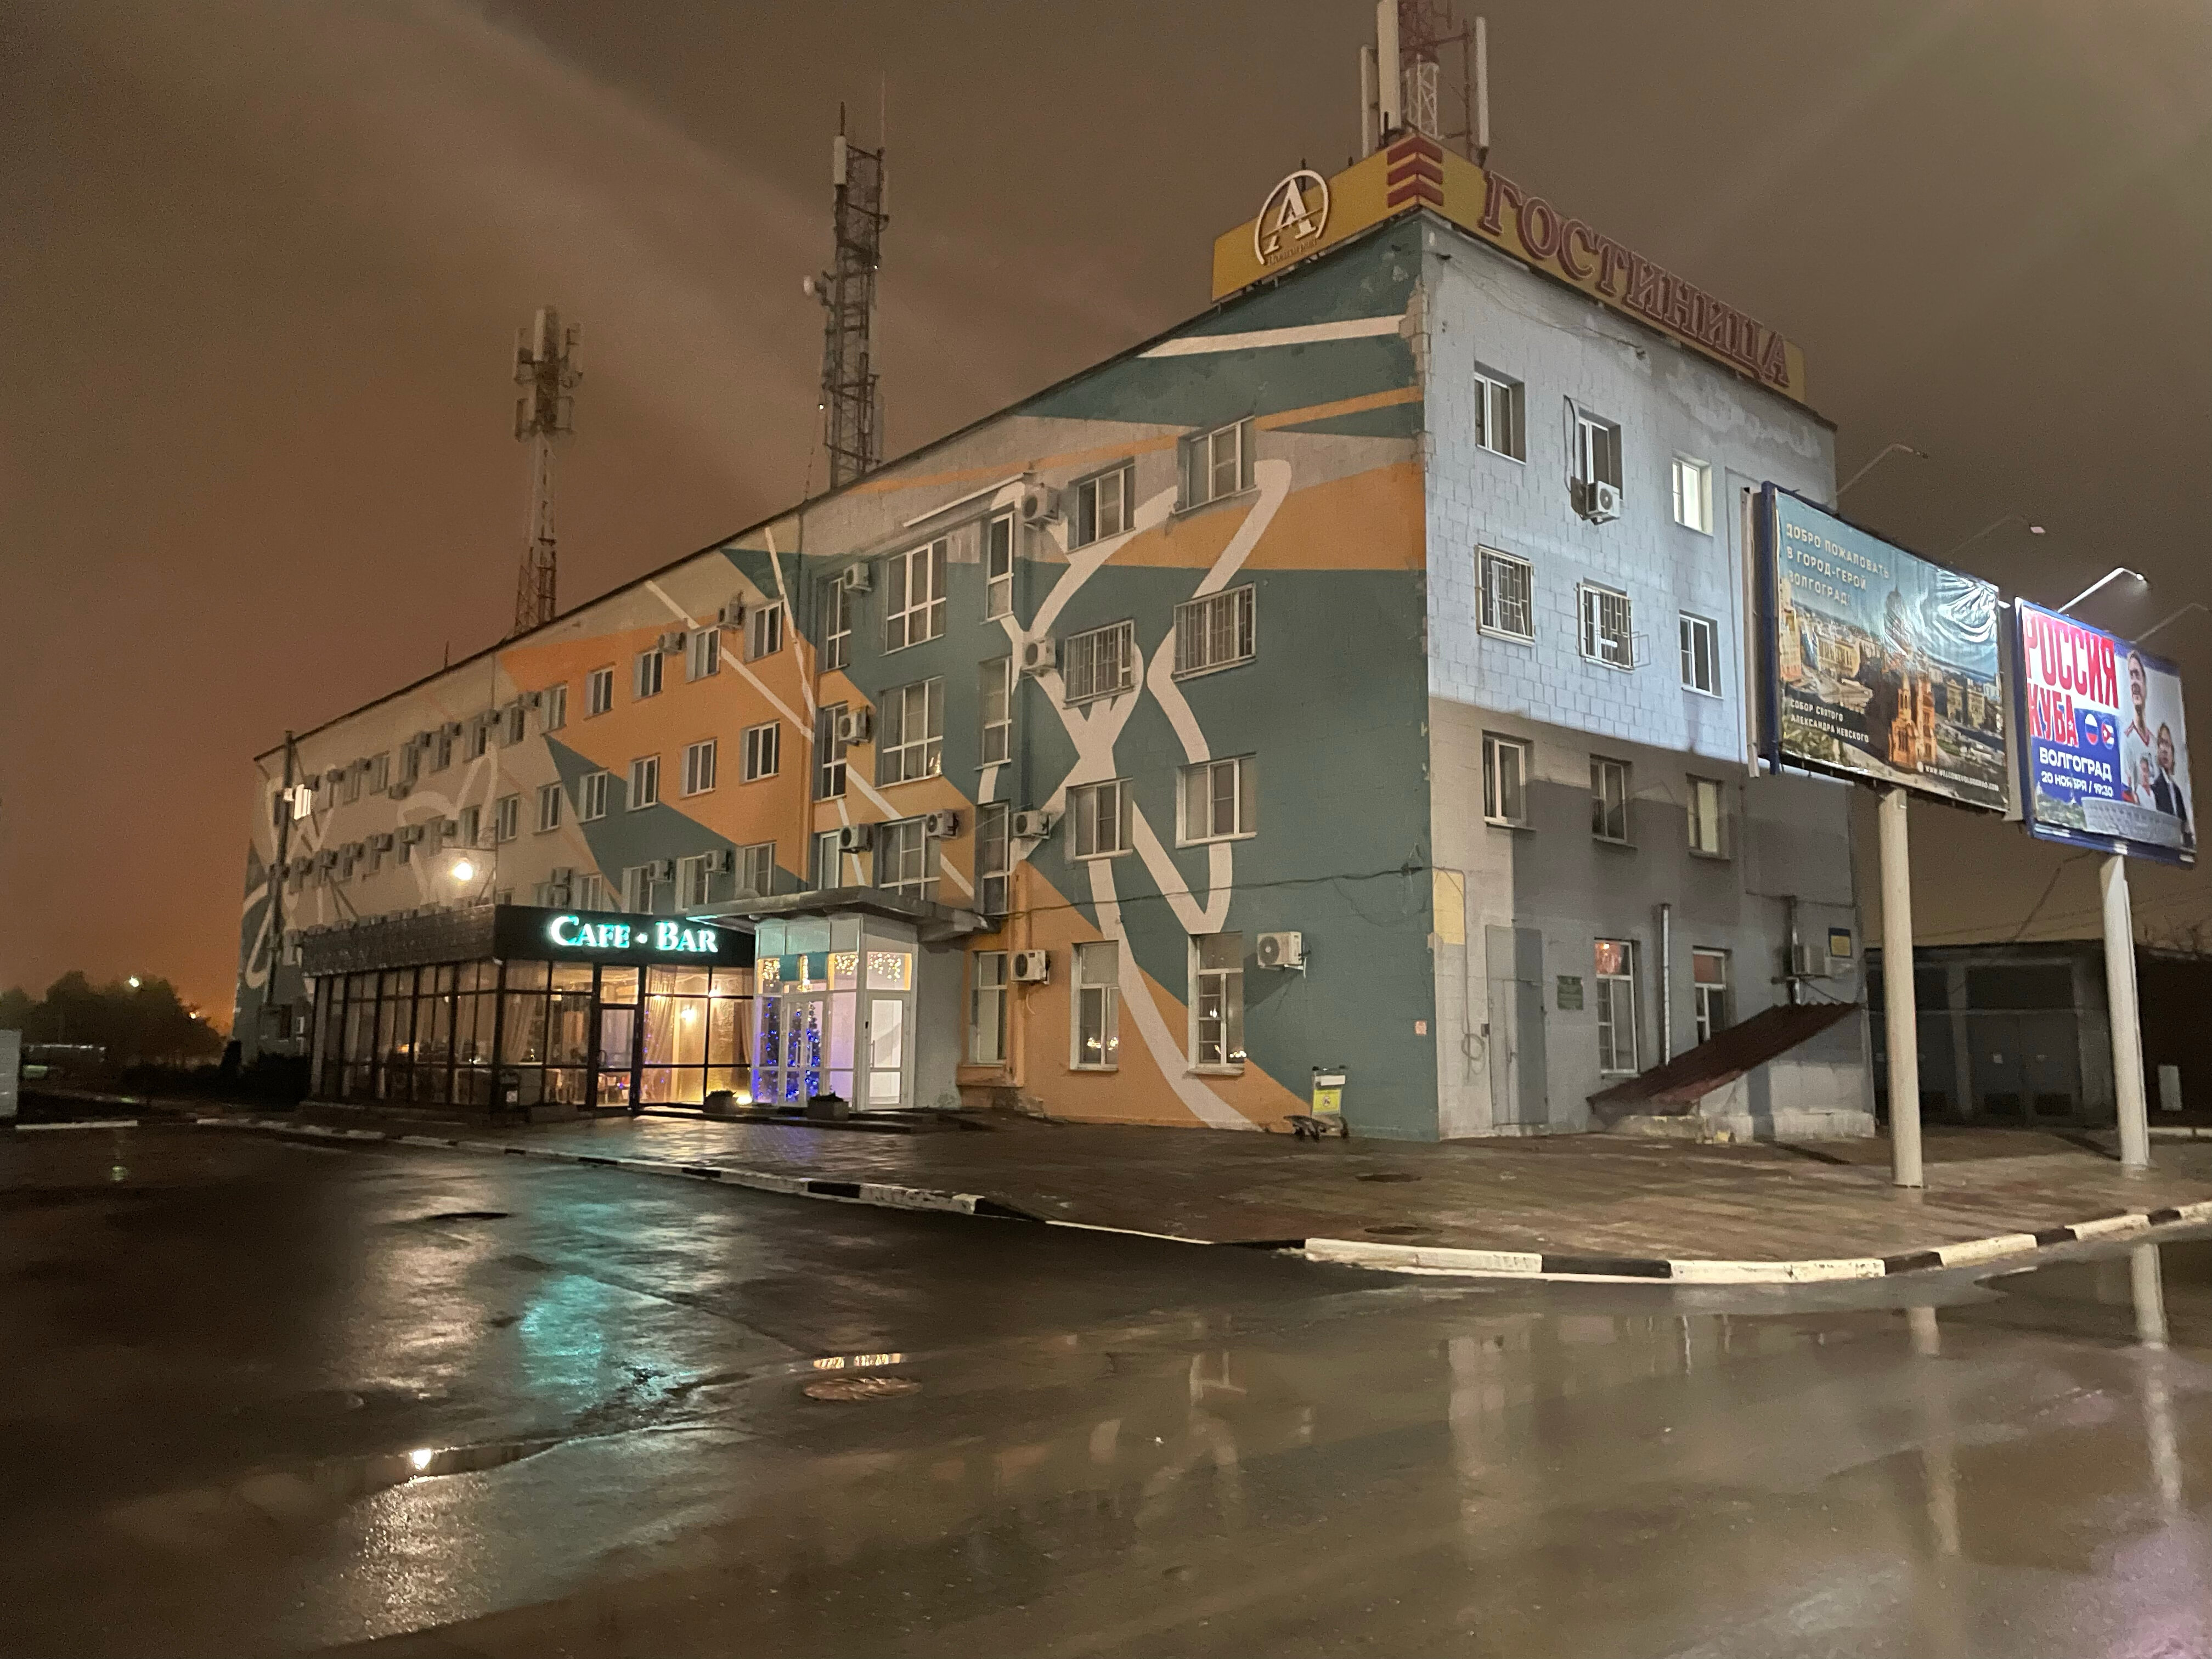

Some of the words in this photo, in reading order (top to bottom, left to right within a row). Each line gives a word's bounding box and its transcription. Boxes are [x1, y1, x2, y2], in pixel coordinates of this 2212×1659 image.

[1480, 170, 1790, 387] ГОСТИНИЦА
[1786, 523, 1821, 548] ДОБРО
[1825, 539, 1889, 579] ПОЖАЛОВАТЬ
[1787, 546, 1793, 559] В
[1797, 550, 1866, 590] ГОРОД-ГЕРОЙ
[2023, 613, 2119, 709] РОССИЯ
[1791, 699, 1814, 712] СОБОР
[1816, 706, 1843, 722] СВЯТОГО
[1791, 714, 1835, 733] АЛЕКСАНДРА
[1837, 727, 1869, 743] НЕВСКОГО
[2028, 682, 2079, 748] КУБА
[2039, 747, 2112, 782] ВОЛГОГРАД
[2041, 771, 2053, 783] 20
[550, 915, 630, 948] CAFE
[656, 921, 718, 952] BAR
